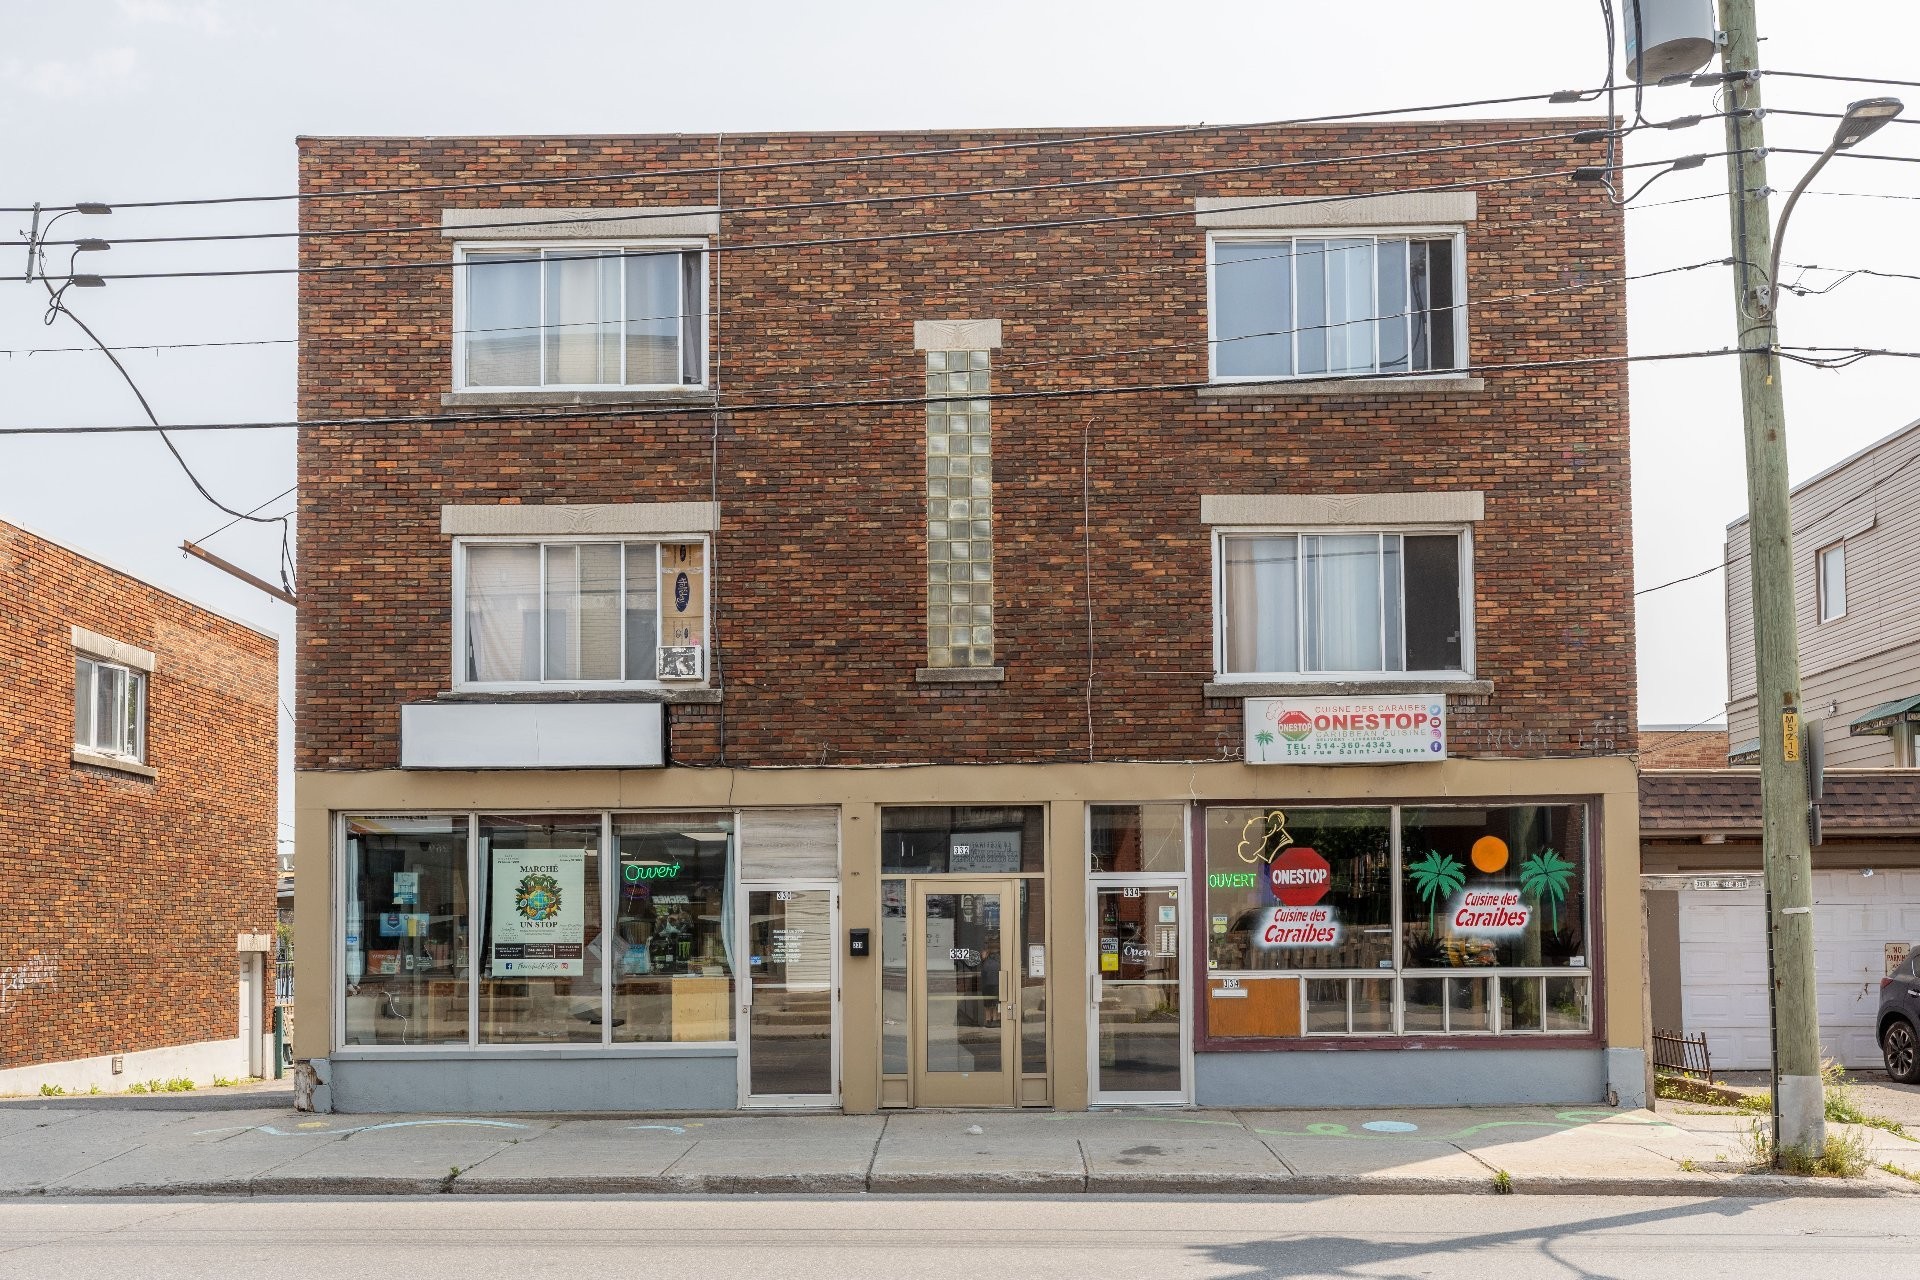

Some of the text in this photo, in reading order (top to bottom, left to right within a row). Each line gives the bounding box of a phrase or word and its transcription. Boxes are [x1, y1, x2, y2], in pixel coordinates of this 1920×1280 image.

[1378, 704, 1426, 712] CARAIBES
[1314, 713, 1428, 731] ONESTOP
[1278, 722, 1312, 733] ONESTOP
[1315, 729, 1426, 738] CARIBBEAN CUISINE
[1316, 741, 1392, 750] 514-360-4343
[1339, 747, 1426, 755] Saint-Jacques
[954, 846, 969, 855] 332
[520, 863, 559, 873] MARCHÉ
[1209, 873, 1257, 888] OUVERT
[1272, 868, 1328, 885] ONESTOP
[1124, 888, 1139, 897] 334
[1465, 891, 1518, 906] Cuisine des
[1274, 908, 1327, 922] Cuisine des
[1455, 907, 1527, 927] Caraibes
[520, 921, 558, 929] UN STOP
[1264, 923, 1336, 943] Caraibes
[950, 949, 969, 959] 332
[1124, 945, 1151, 959] Open
[1893, 946, 1902, 954] NO
[1887, 954, 1908, 962] PARKIN
[1224, 979, 1239, 988] 334
